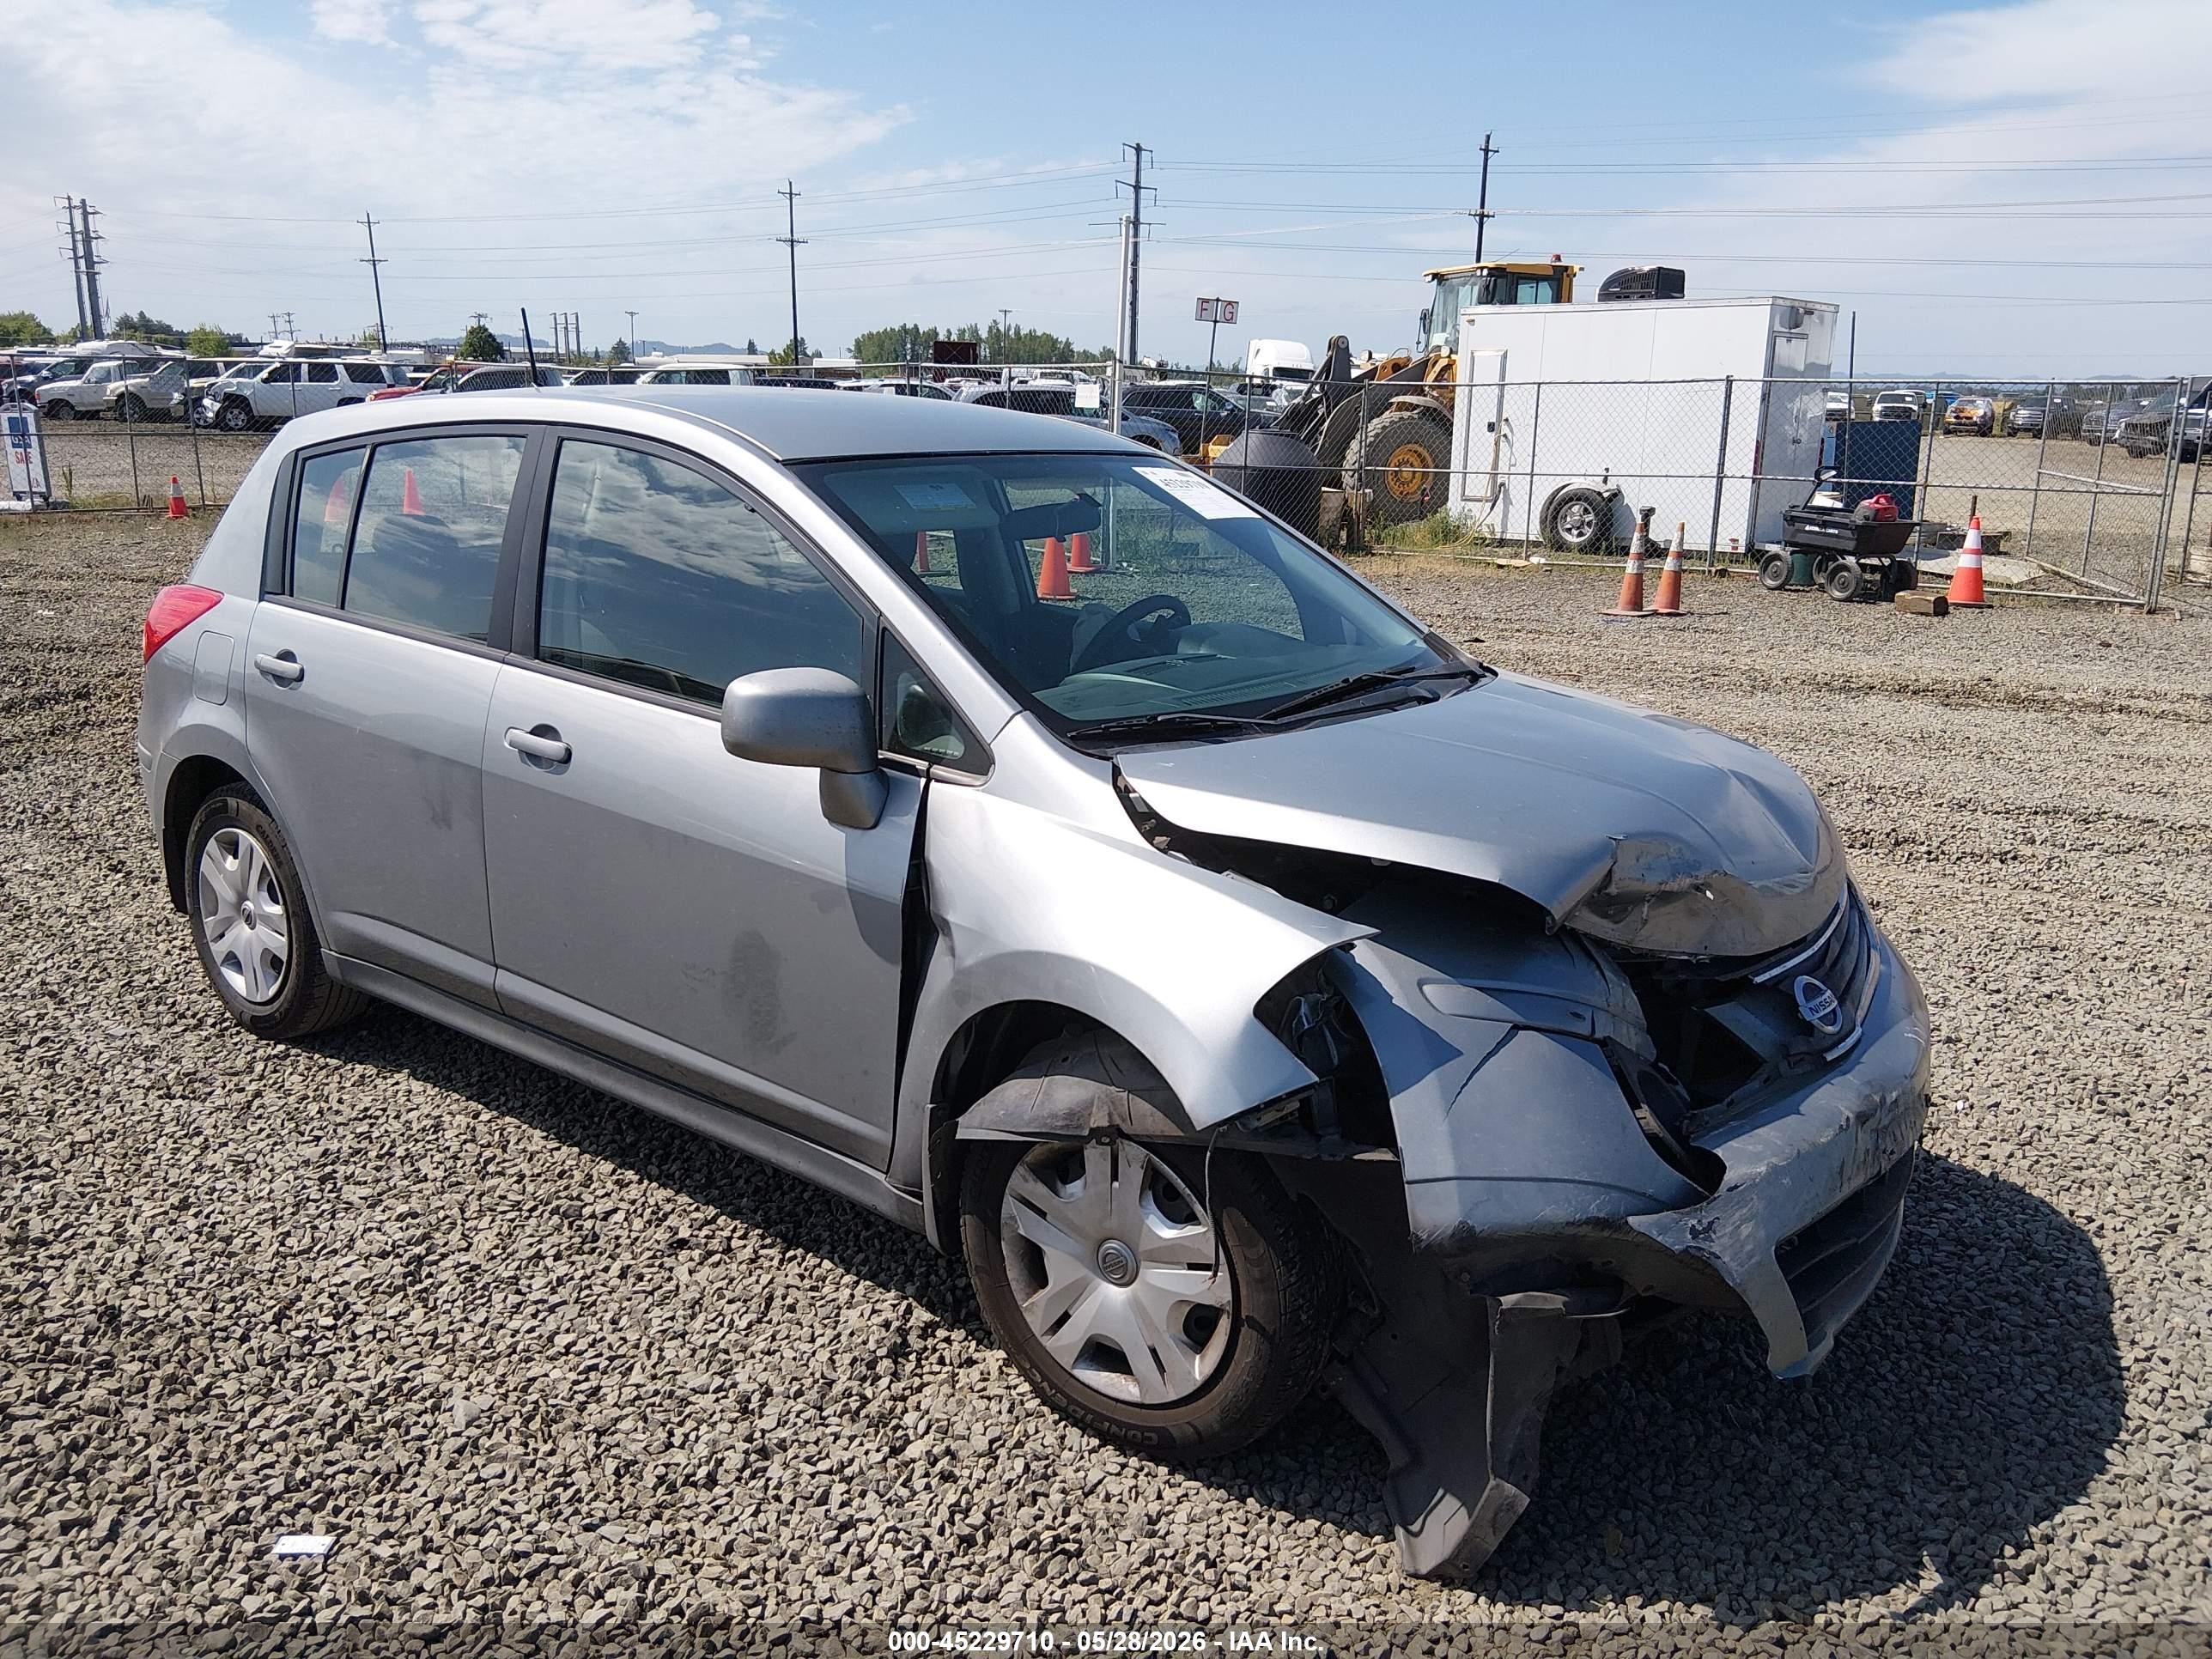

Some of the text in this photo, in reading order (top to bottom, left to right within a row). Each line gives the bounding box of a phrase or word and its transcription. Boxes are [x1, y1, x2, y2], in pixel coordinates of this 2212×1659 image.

[1200, 301, 1210, 319] F
[1223, 302, 1235, 321] G
[15, 450, 33, 465] SAE
